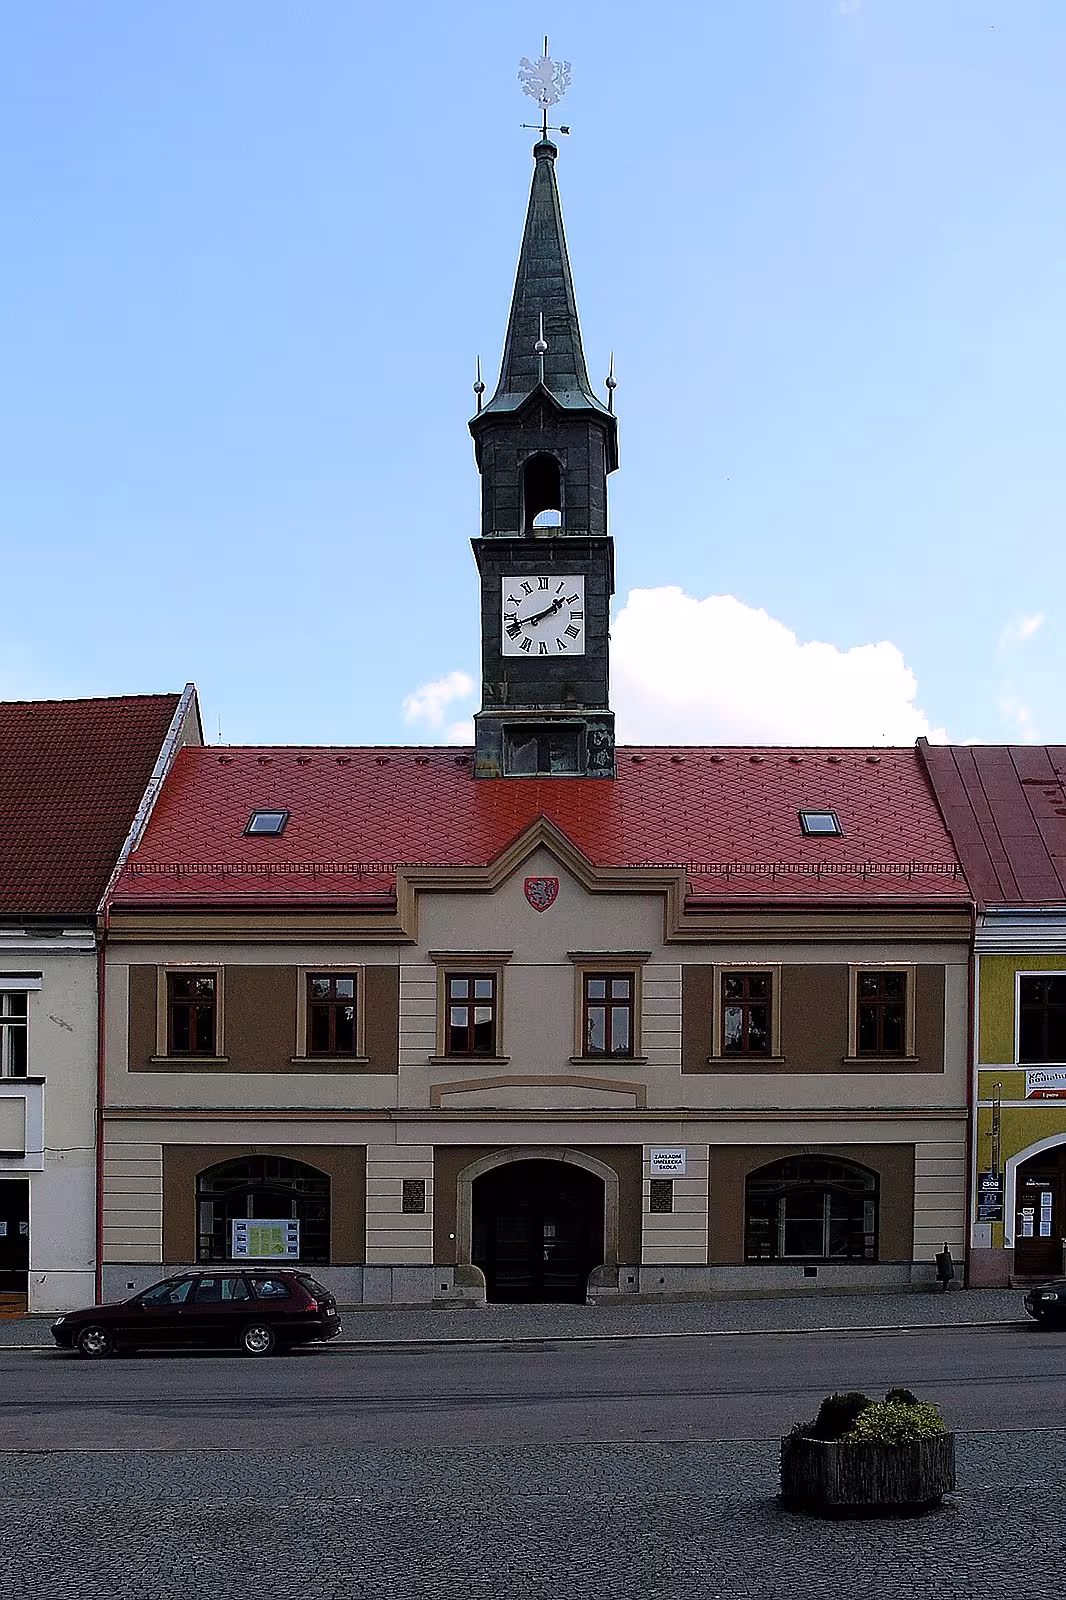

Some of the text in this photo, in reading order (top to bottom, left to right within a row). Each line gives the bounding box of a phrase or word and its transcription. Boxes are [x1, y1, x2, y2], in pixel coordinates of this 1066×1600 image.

[520, 581, 533, 596] XI
[537, 577, 549, 590] XII
[555, 581, 565, 594] I
[506, 594, 522, 606] X
[566, 593, 580, 605] II
[569, 611, 583, 620] III
[564, 624, 581, 639] IIII
[519, 636, 533, 653] VII
[539, 641, 549, 654] VI
[555, 637, 568, 651] V
